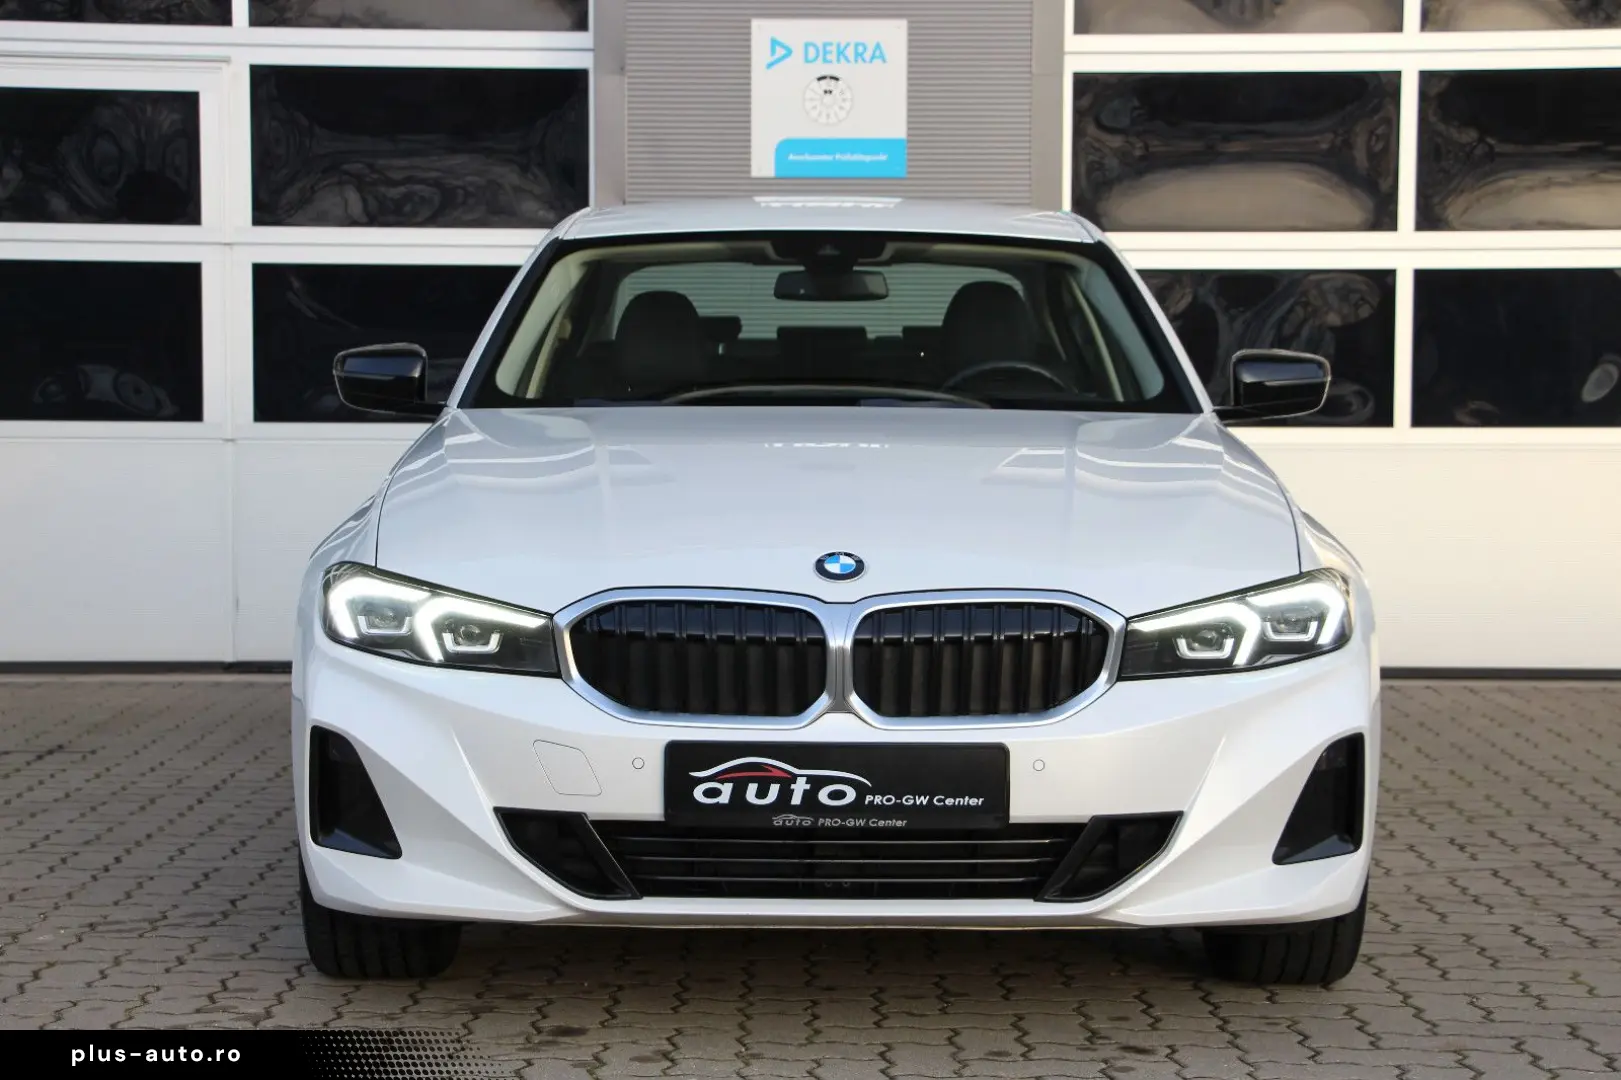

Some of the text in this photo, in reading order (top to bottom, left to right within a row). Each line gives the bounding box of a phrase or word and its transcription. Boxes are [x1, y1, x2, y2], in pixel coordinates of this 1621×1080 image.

[803, 41, 887, 64] DEKRA
[692, 776, 985, 807] auto PRO-GW Center
[817, 817, 866, 827] PRO-GW
[868, 818, 908, 828] Center
